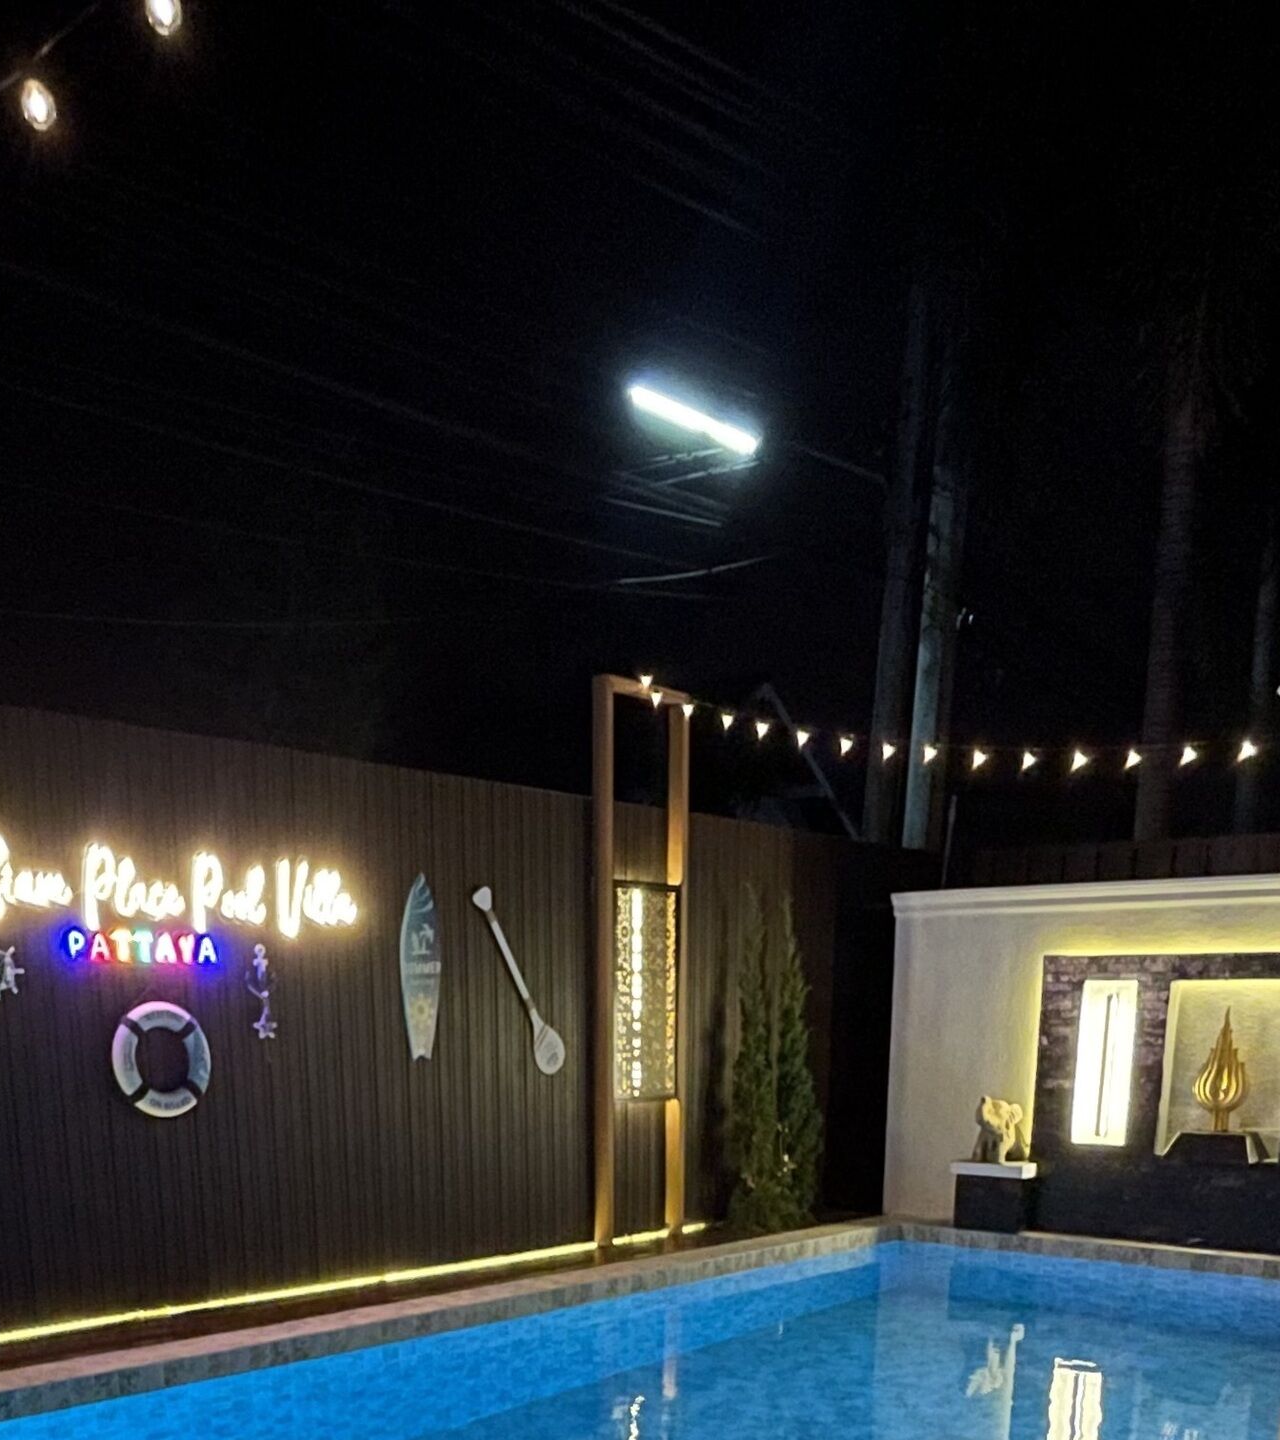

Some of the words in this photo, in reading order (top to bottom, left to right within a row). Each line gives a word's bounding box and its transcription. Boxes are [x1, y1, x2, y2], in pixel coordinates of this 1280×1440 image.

[83, 842, 186, 932] Place
[191, 850, 267, 934] Pool
[275, 855, 358, 940] Villa
[67, 927, 219, 964] PATTAYA
